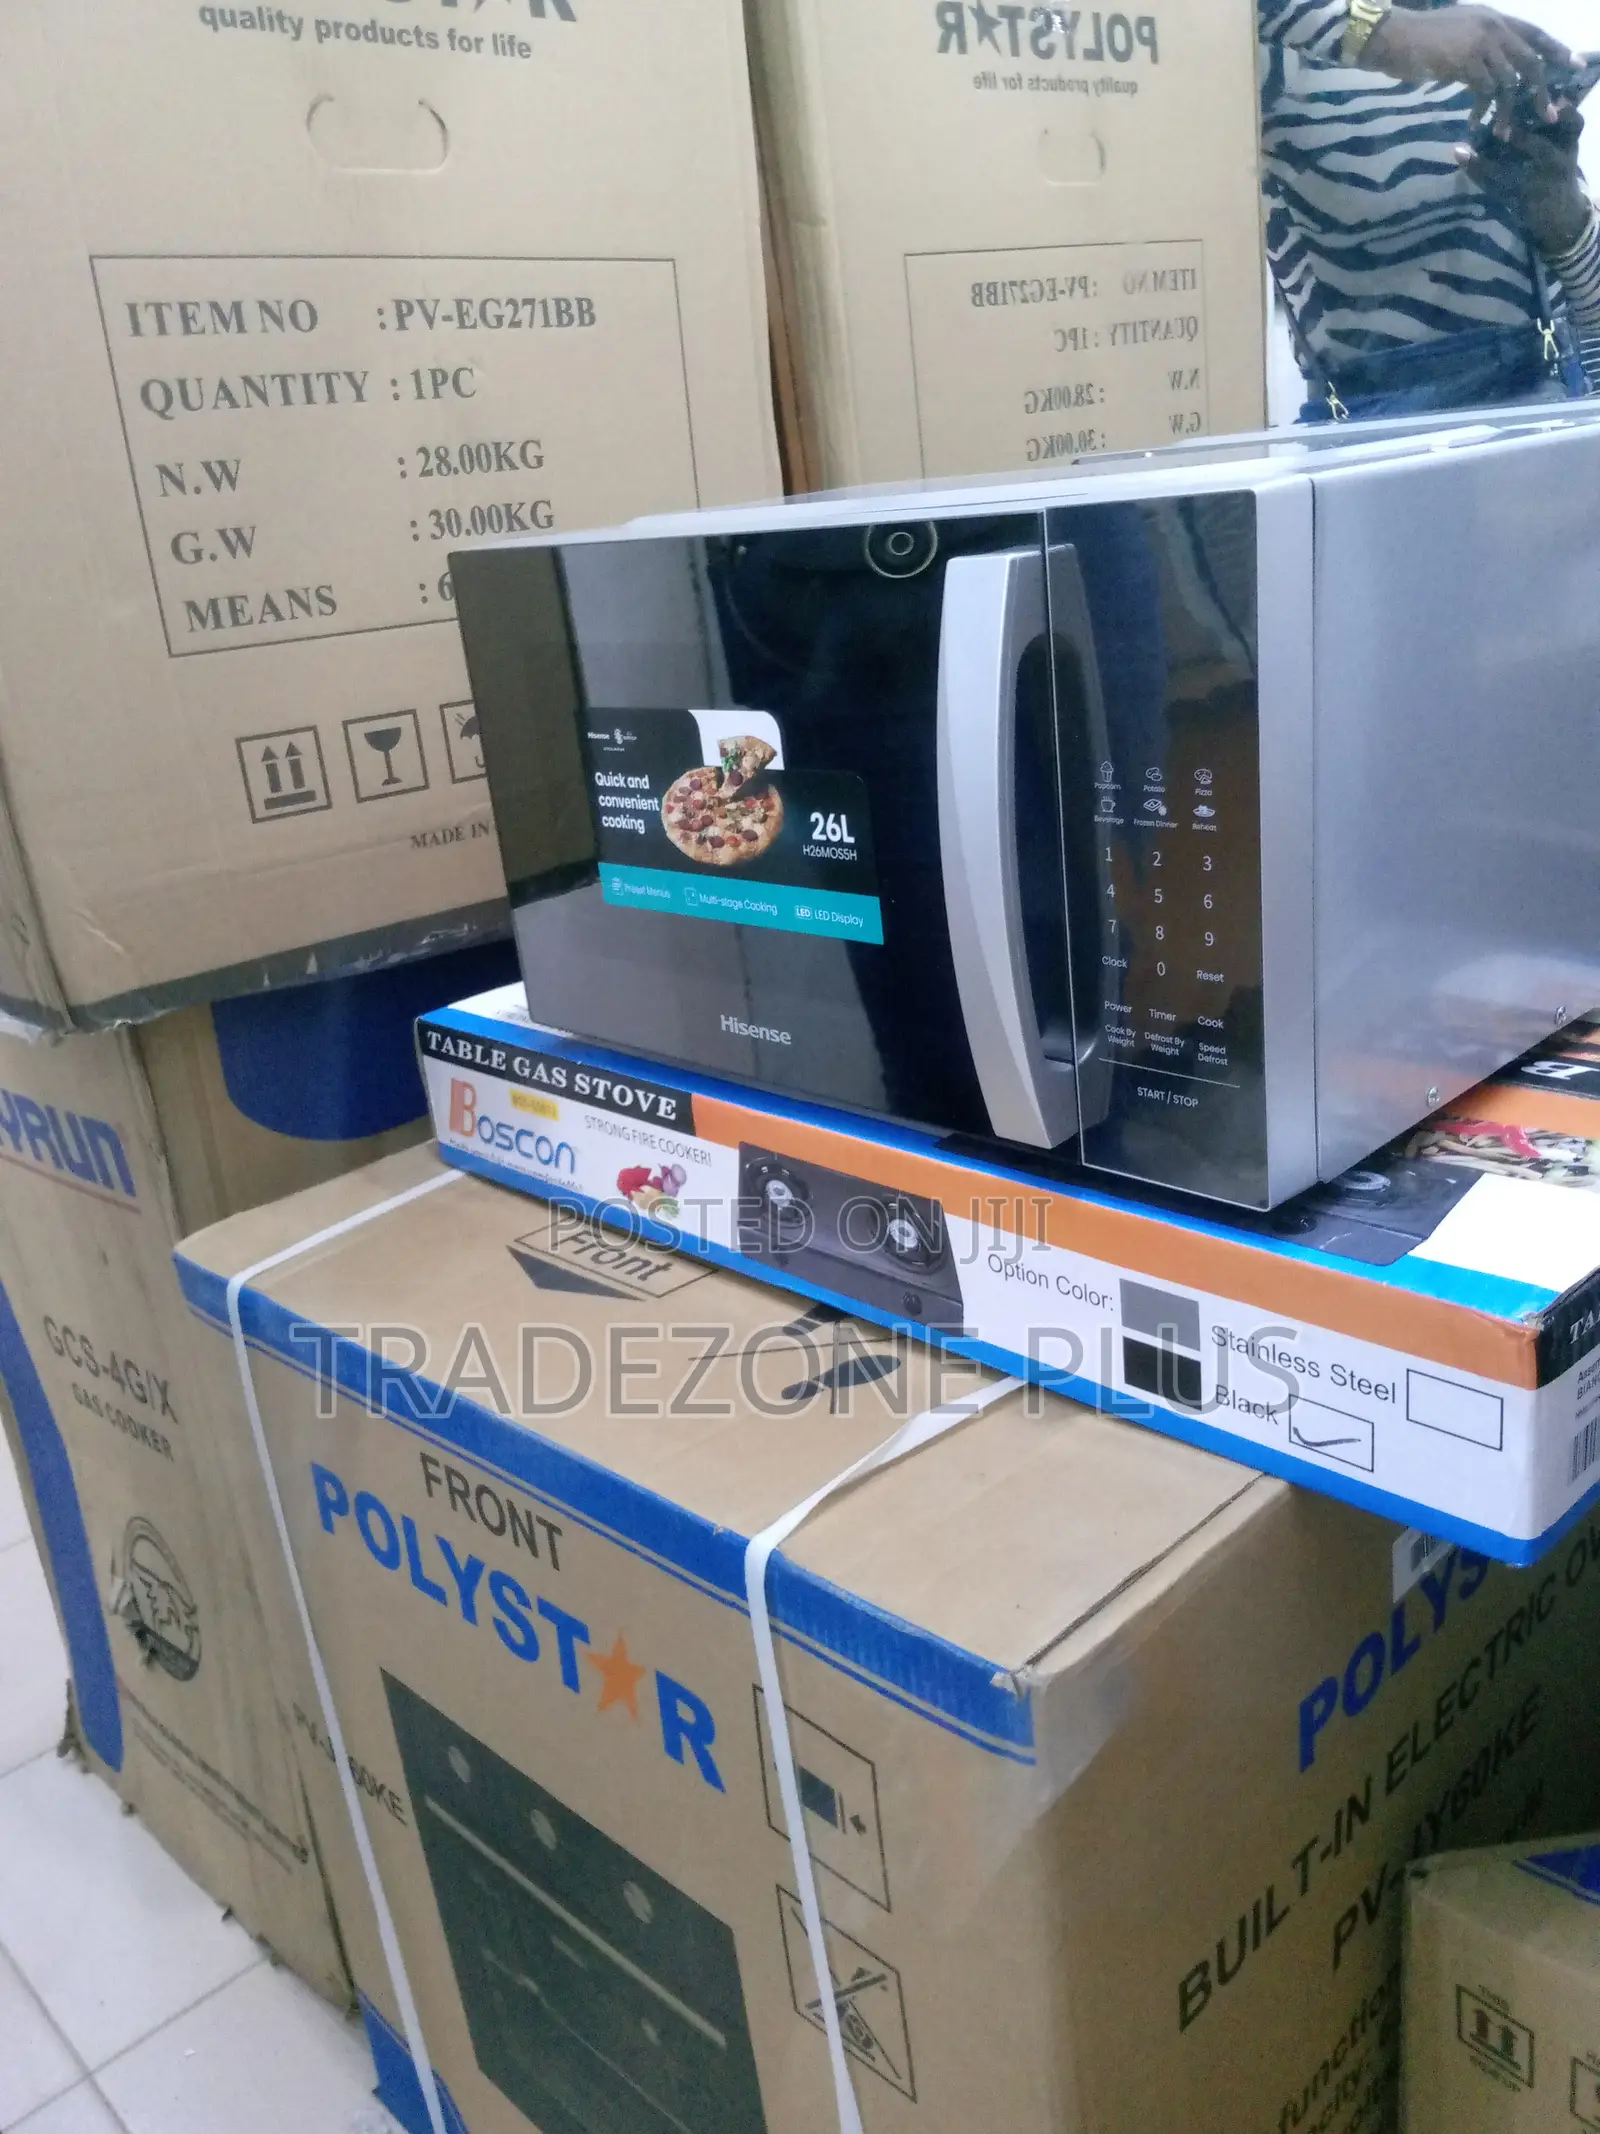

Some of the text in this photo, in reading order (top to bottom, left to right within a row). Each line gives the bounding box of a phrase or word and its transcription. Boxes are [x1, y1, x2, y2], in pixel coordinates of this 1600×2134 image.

[200, 4, 532, 59] quality products for life
[125, 300, 248, 337] ITEM
[257, 299, 318, 333] NO
[140, 371, 369, 421] QUANTITY
[155, 459, 241, 497] N.W
[170, 525, 257, 565] G.W
[183, 584, 337, 633] MEANS
[595, 771, 650, 790] Quick and
[1094, 782, 1121, 790] Popcorn
[1143, 785, 1165, 793] Potato
[1195, 788, 1212, 796] Pizza
[598, 794, 660, 812] convenient
[602, 814, 645, 835] cooking
[810, 811, 855, 844] 26L
[1094, 815, 1124, 825] Beverage
[1133, 818, 1178, 829] Frozen Dinner
[1192, 822, 1217, 832] Reheat
[411, 821, 490, 849] MADE IN
[1105, 847, 1113, 862] 1
[1152, 851, 1162, 867] 2
[1203, 855, 1212, 871] 3
[624, 883, 671, 899] Preset Menus
[1106, 883, 1116, 898] 4
[1154, 888, 1163, 903] 5
[699, 893, 778, 916] Multi-stage Cooking
[1203, 894, 1213, 909] 6
[814, 910, 864, 928] LED Display
[1108, 919, 1116, 934] 7
[1155, 925, 1164, 940] 8
[1204, 931, 1214, 947] 9
[1101, 955, 1128, 969] Clock
[1156, 961, 1165, 976] 0
[1196, 969, 1224, 983] Reset
[1104, 1001, 1133, 1013] Power
[1149, 1008, 1176, 1022] Timer
[720, 1014, 791, 1045] Hisense
[1197, 1015, 1224, 1029] Cook
[1105, 1024, 1136, 1038] Cook By
[1107, 1034, 1135, 1048] Weight
[1144, 1031, 1185, 1048] Defrost By
[1150, 1043, 1180, 1056] Weight
[1198, 1042, 1226, 1055] Speed
[1197, 1053, 1228, 1066] Defrost
[427, 1030, 507, 1071] TABLE
[513, 1056, 567, 1089] GAS
[574, 1072, 677, 1120] STOVE
[1137, 1087, 1165, 1101] START
[1173, 1094, 1199, 1108] STOP
[584, 1115, 712, 1167] STRONG FIRE COOKER!
[554, 1229, 673, 1281] Front
[987, 1253, 1114, 1312] Option Color:
[1211, 1325, 1396, 1404] Stainless Steel
[1215, 1384, 1280, 1426] Black
[105, 1401, 174, 1462] COOKER
[420, 1451, 563, 1572] FRONT
[1386, 1573, 1556, 1796] ELECTRIC
